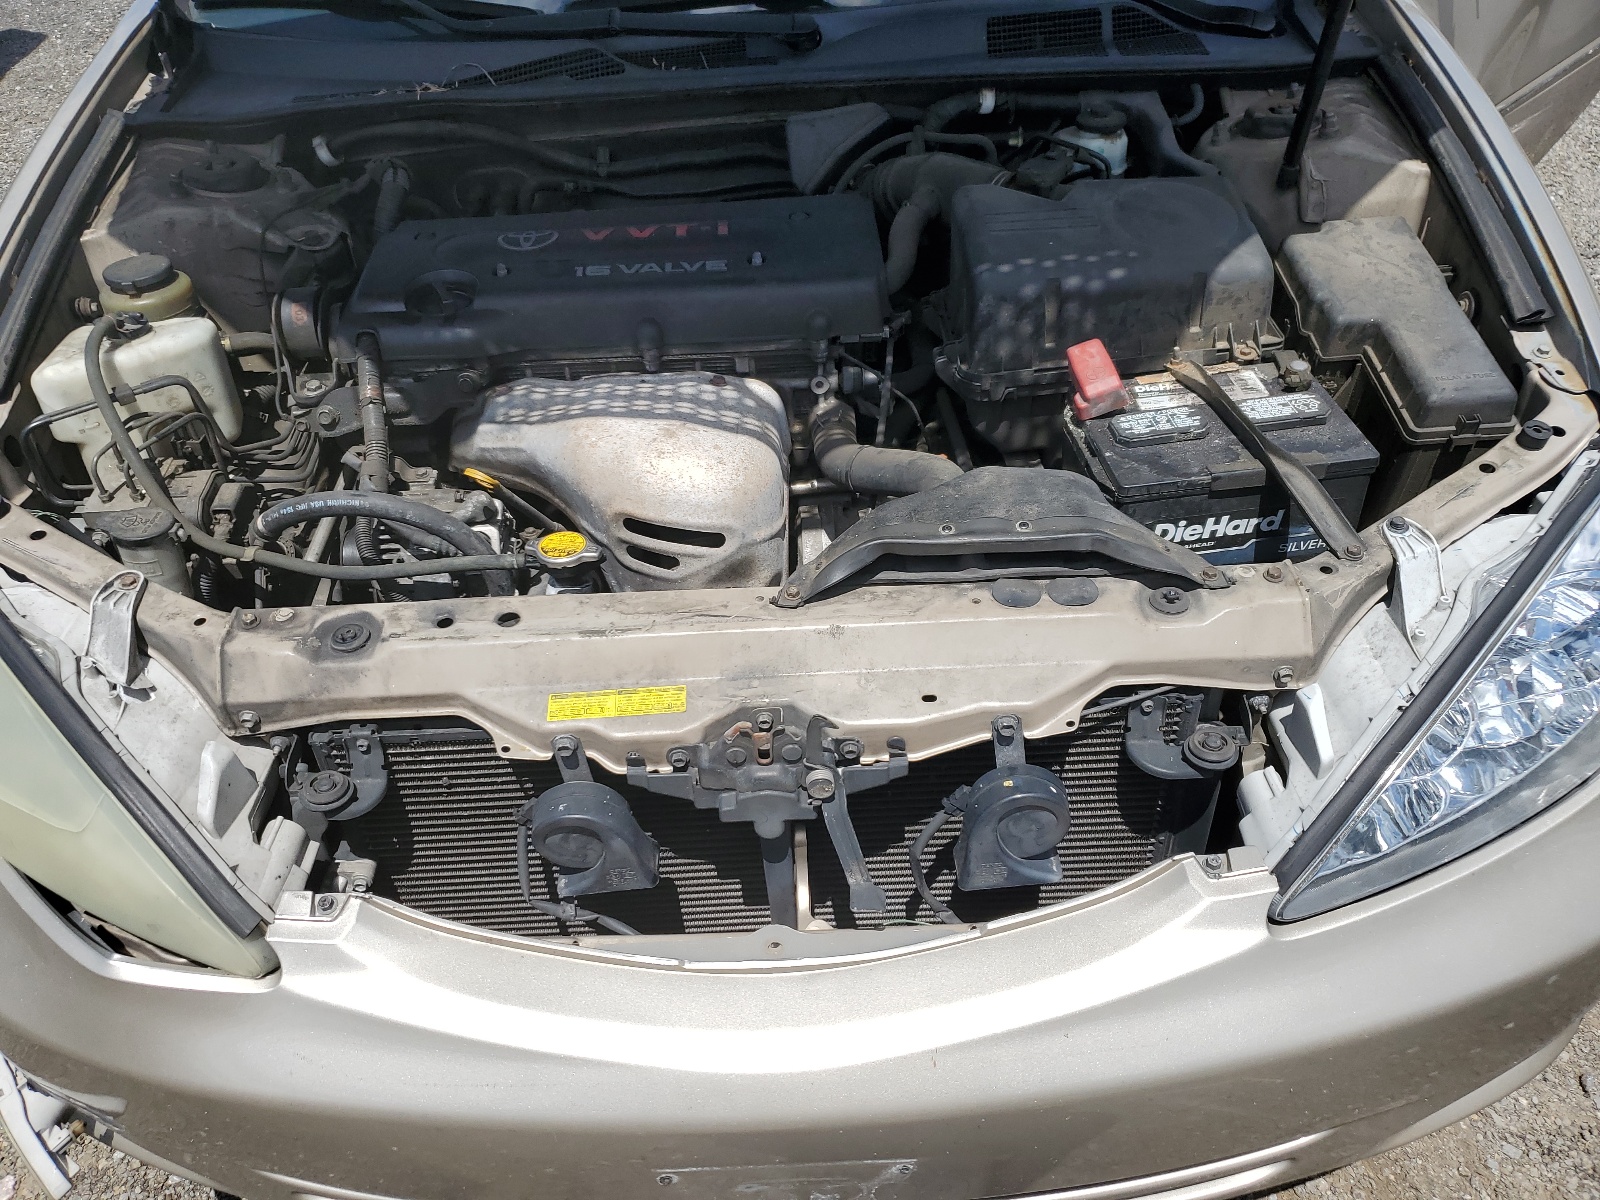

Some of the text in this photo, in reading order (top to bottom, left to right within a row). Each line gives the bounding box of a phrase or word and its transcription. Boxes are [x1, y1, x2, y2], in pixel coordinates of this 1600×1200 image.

[574, 259, 728, 277] 16 VALVE
[309, 500, 324, 508] USA
[1155, 509, 1285, 542] DieHard
